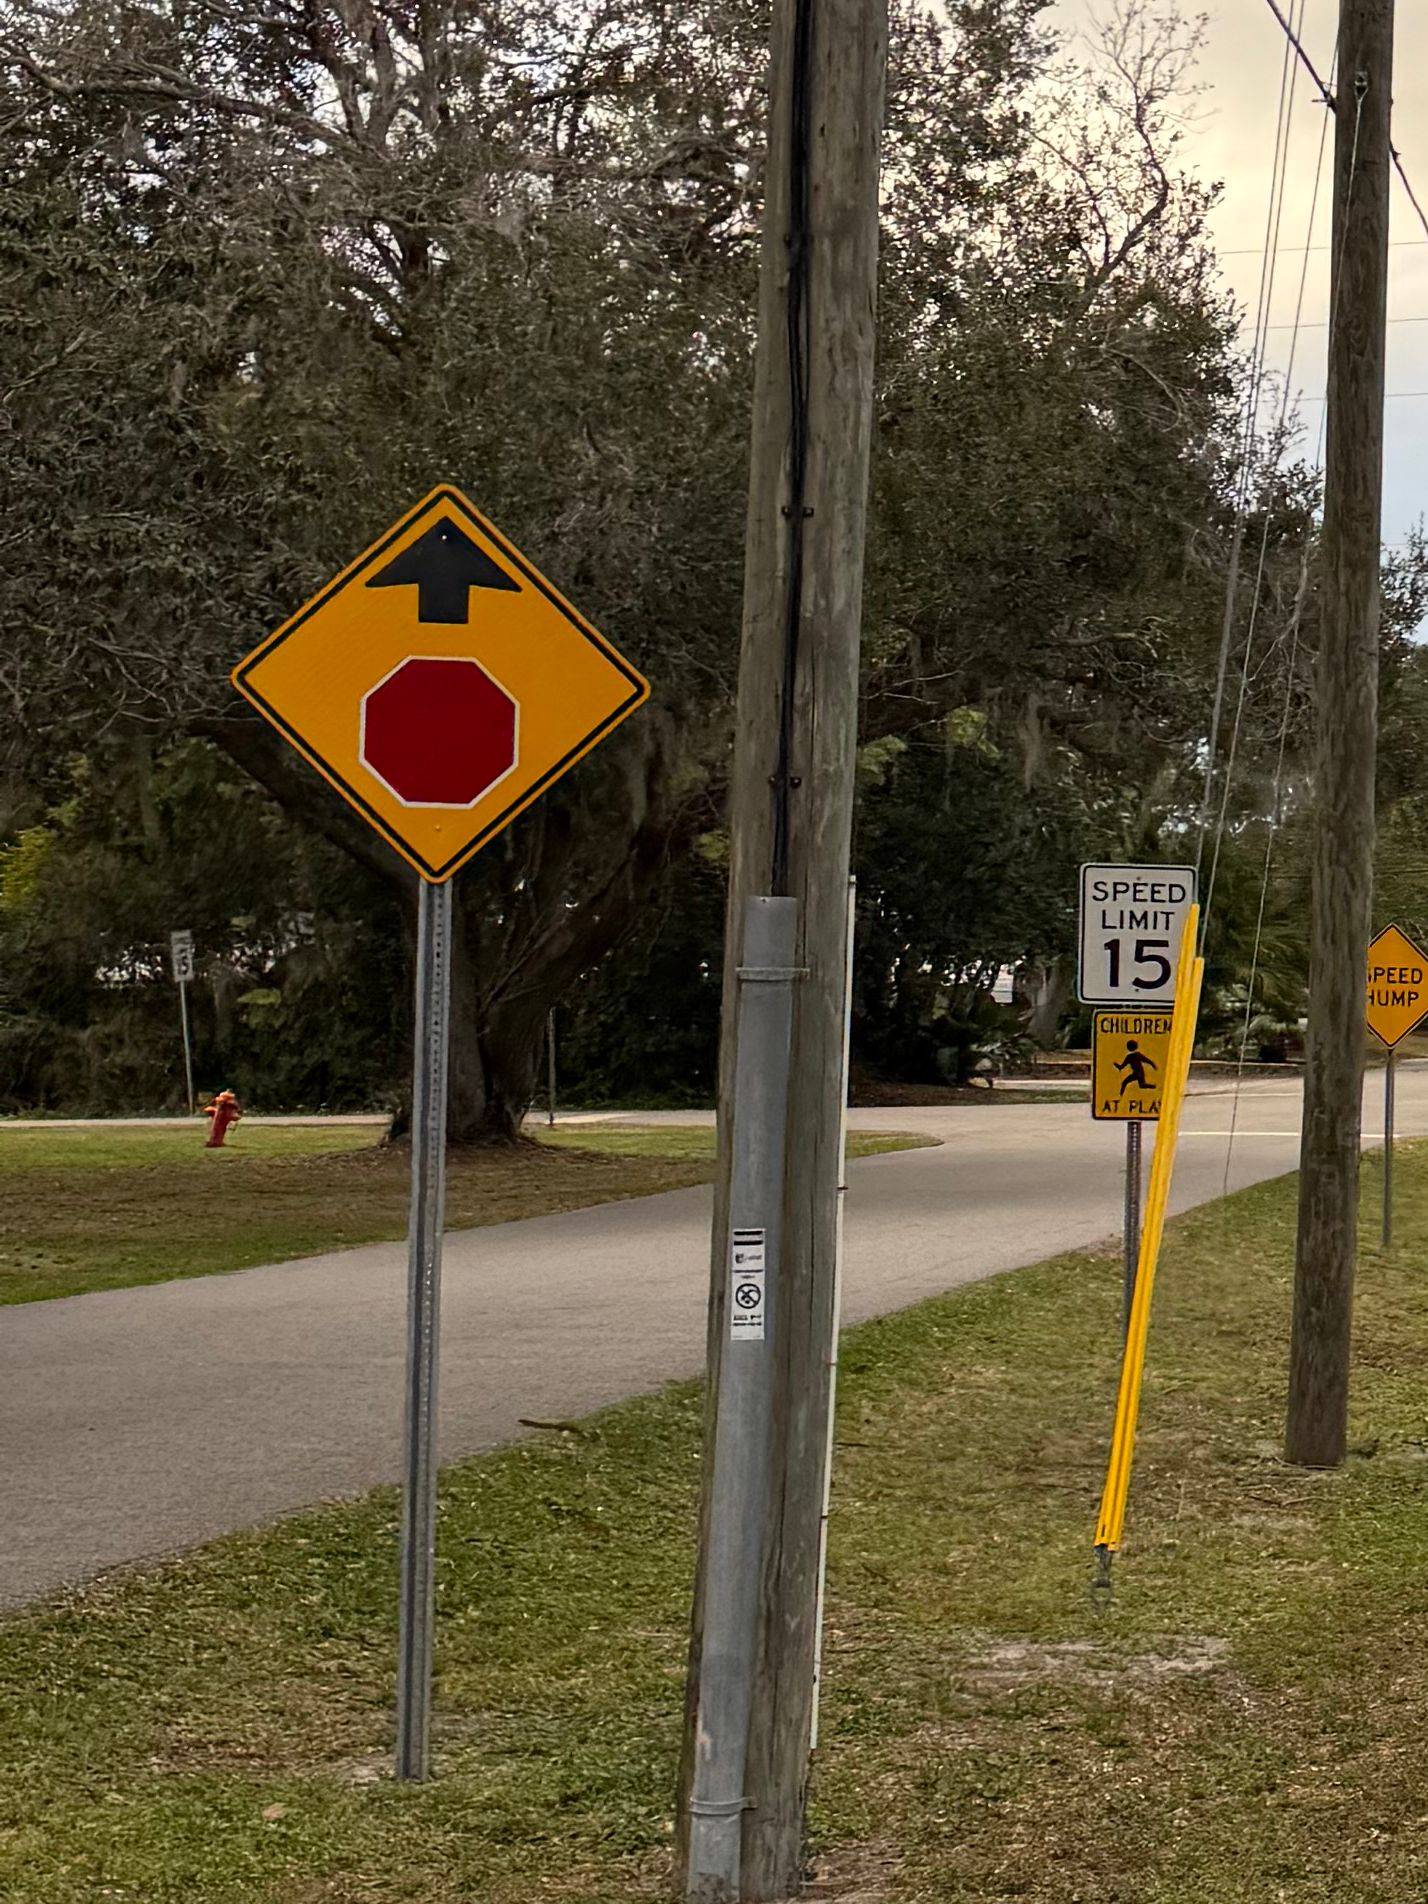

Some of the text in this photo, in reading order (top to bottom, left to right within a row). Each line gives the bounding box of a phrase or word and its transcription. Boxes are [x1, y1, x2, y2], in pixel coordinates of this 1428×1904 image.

[1092, 881, 1186, 903] SPEED
[1102, 909, 1175, 931] LIMIT
[1104, 939, 1171, 989] 15
[1368, 967, 1423, 984] PEED
[1101, 1018, 1172, 1034] CHILDREN
[1103, 1100, 1120, 1113] AT
